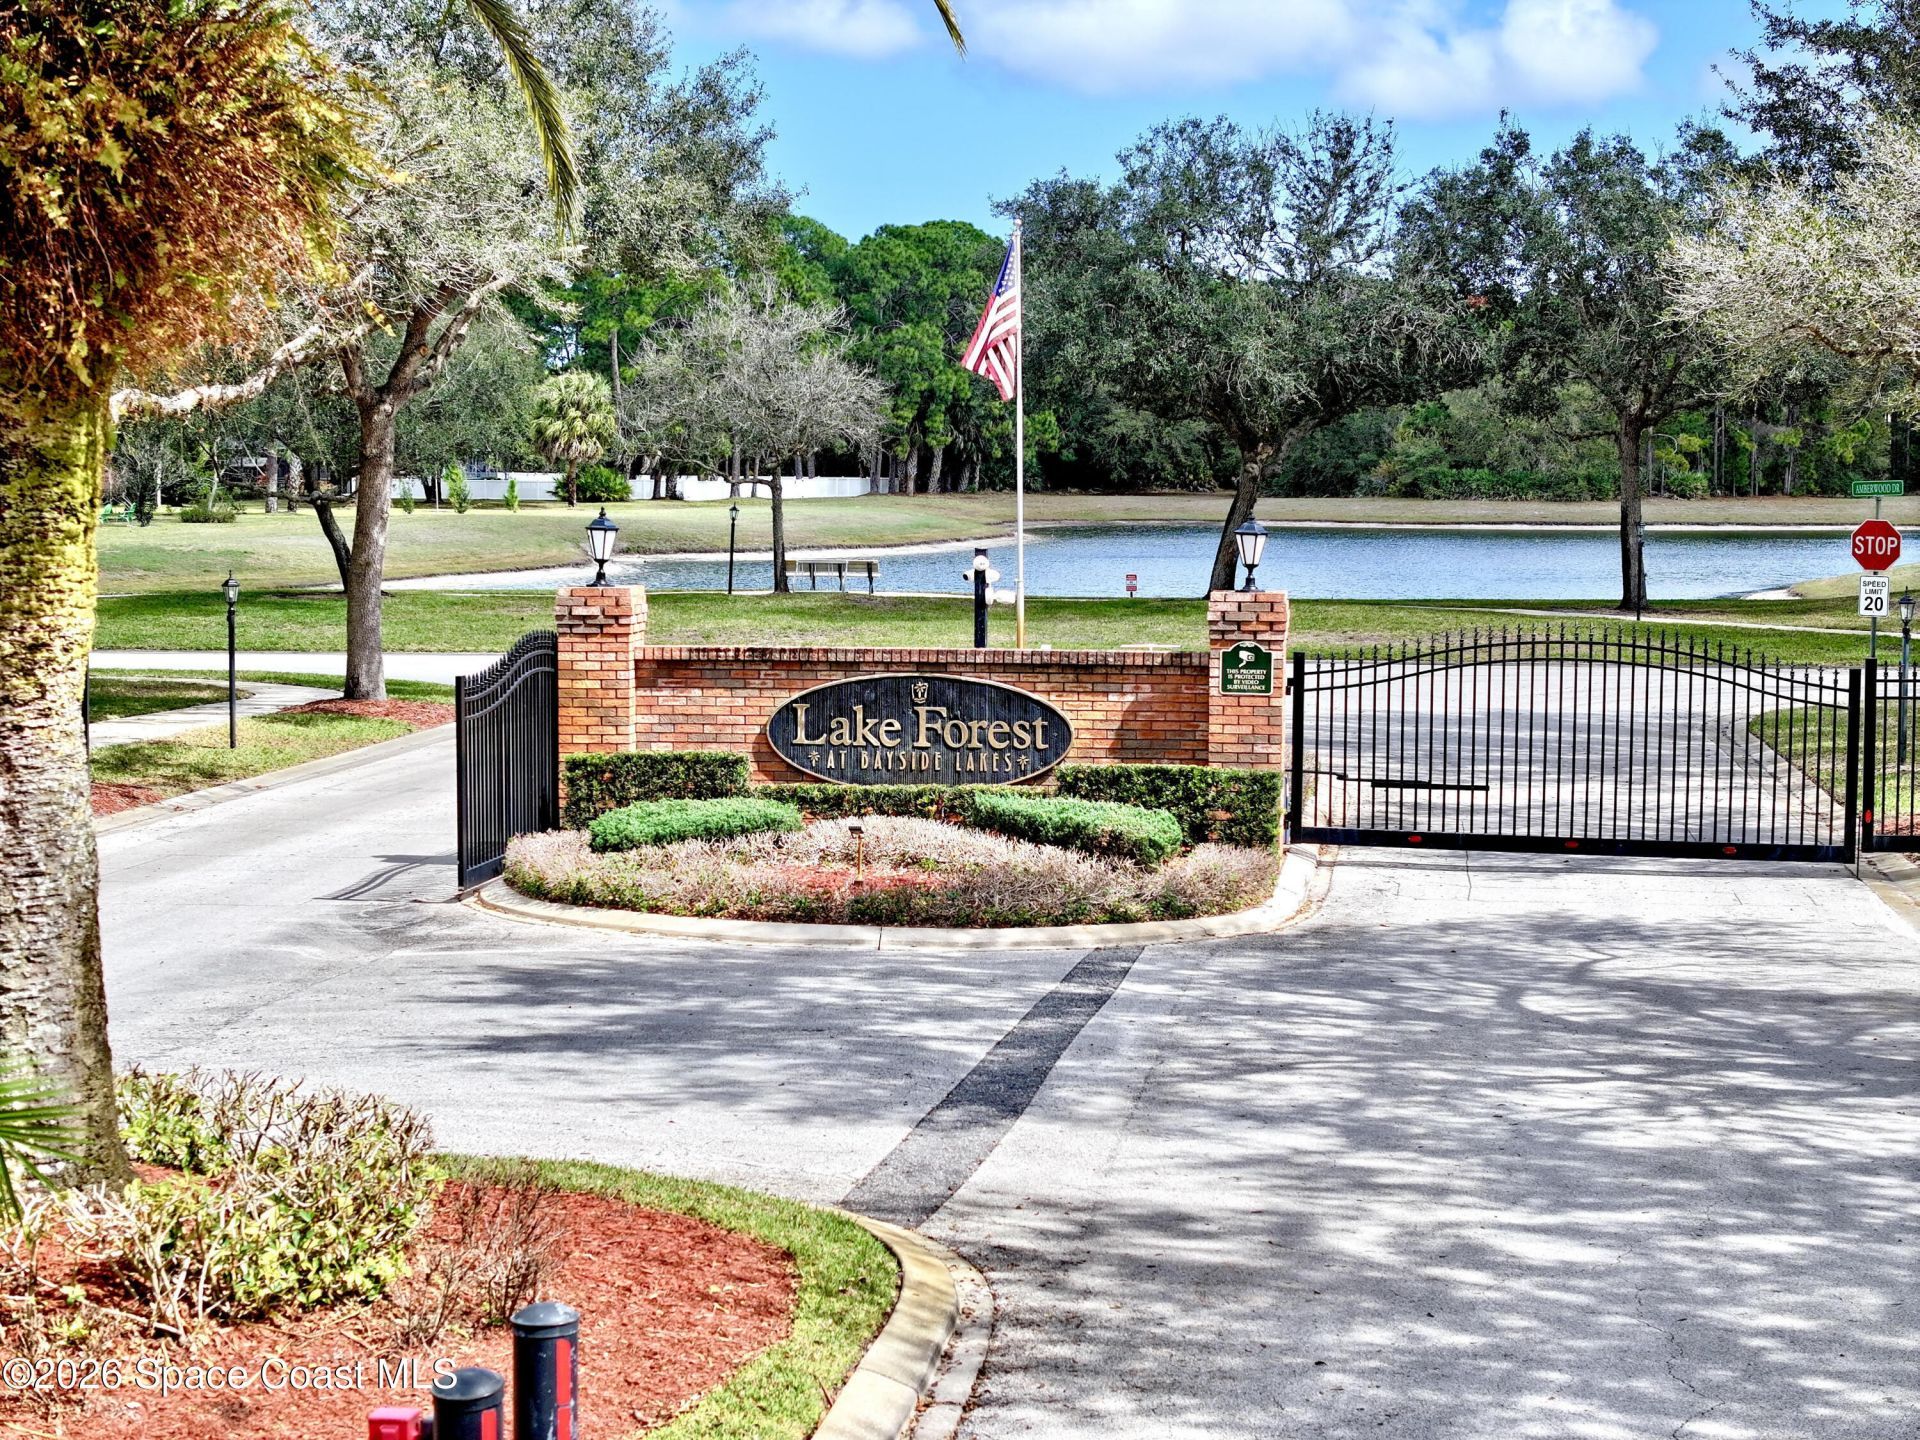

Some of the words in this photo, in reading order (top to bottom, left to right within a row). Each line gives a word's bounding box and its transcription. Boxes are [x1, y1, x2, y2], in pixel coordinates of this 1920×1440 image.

[1855, 484, 1891, 494] AMBERWOOD
[1891, 483, 1901, 493] DR
[1854, 535, 1898, 556] STOP
[1862, 580, 1887, 588] SPEED
[1863, 596, 1884, 612] 20
[791, 703, 901, 748] Lake
[912, 706, 1050, 750] Forest
[826, 750, 847, 770] AT
[860, 751, 942, 771] BAYSIDE
[955, 752, 1012, 772] LAKES
